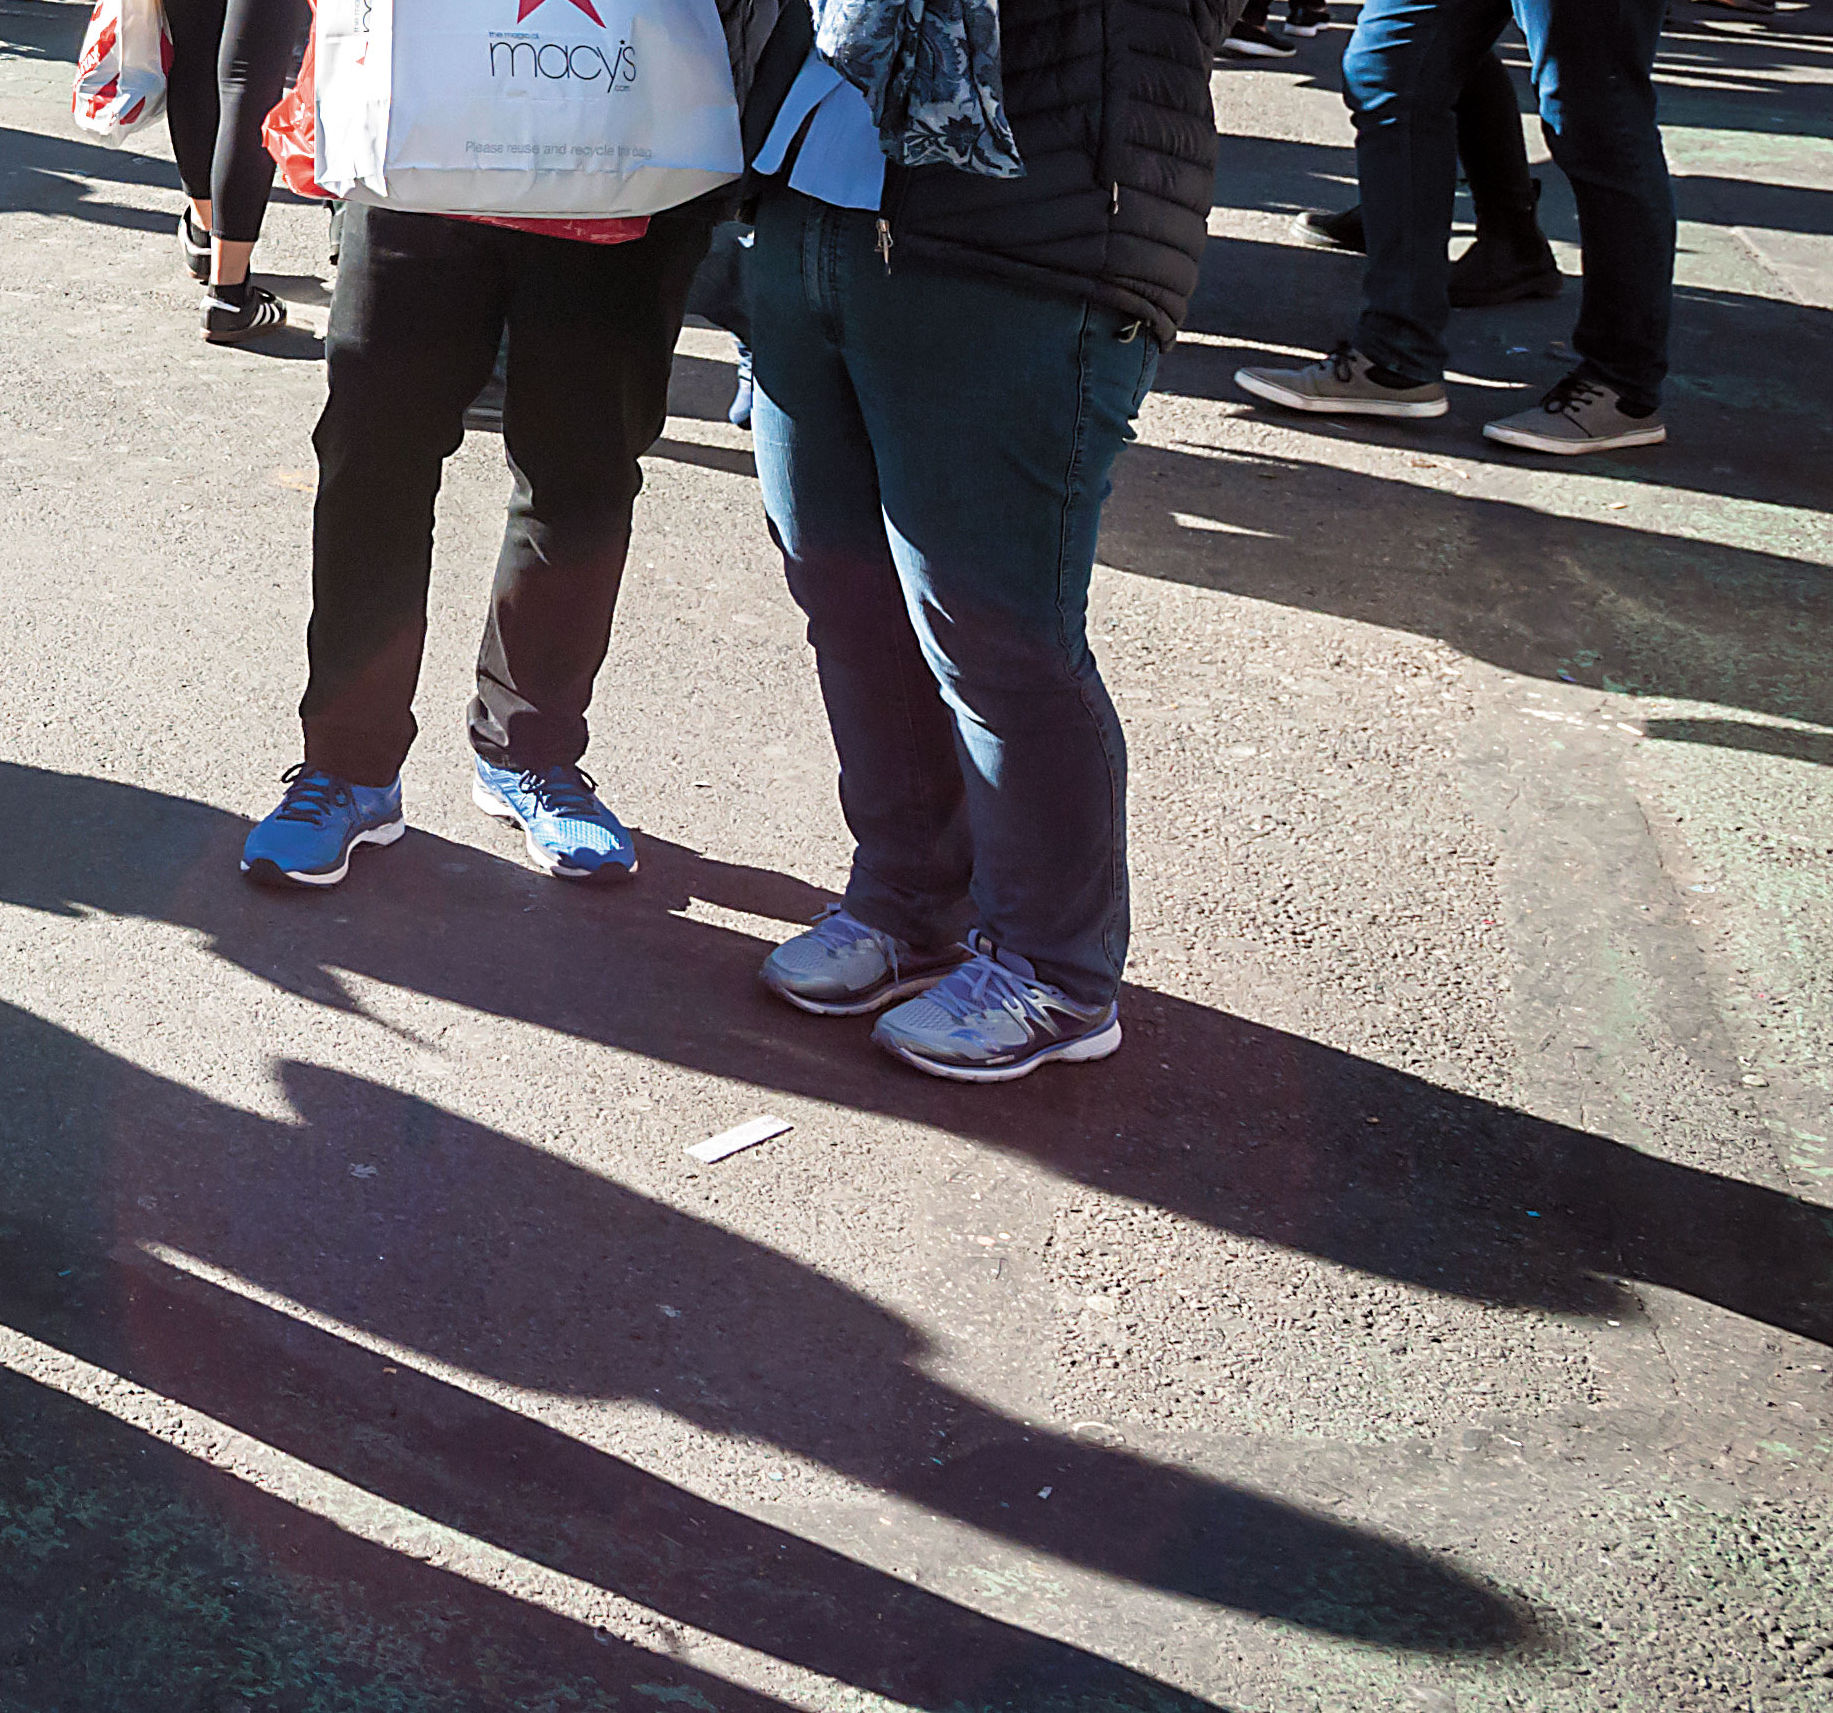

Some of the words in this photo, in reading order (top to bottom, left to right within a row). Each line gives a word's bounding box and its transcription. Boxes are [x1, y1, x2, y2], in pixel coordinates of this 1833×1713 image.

[465, 141, 503, 154] Please
[506, 144, 538, 154] reuse
[543, 143, 567, 155] and
[570, 144, 614, 159] recycle
